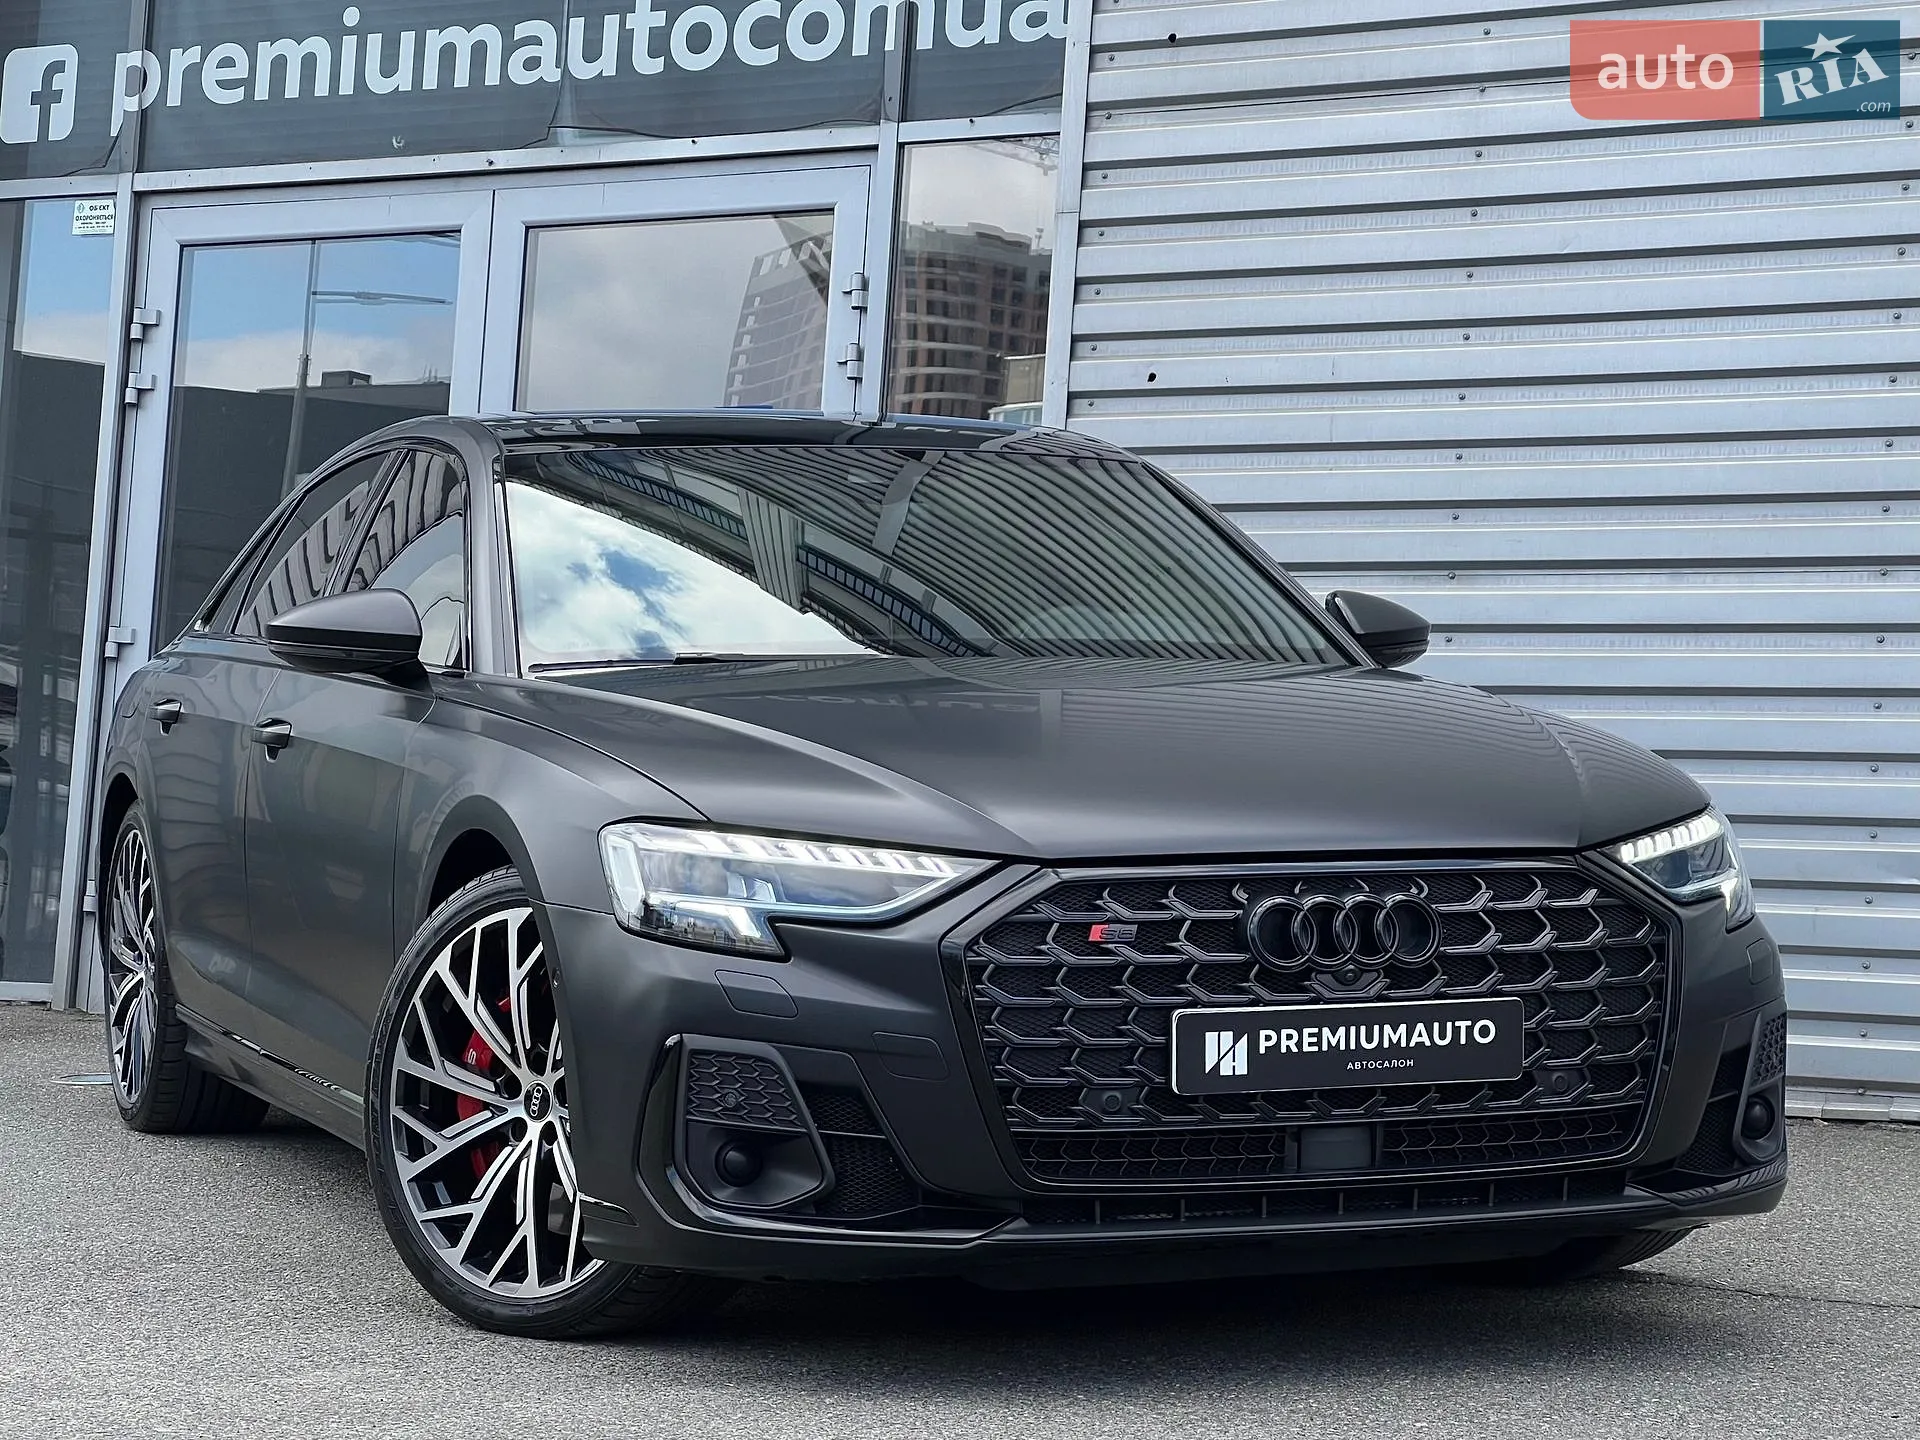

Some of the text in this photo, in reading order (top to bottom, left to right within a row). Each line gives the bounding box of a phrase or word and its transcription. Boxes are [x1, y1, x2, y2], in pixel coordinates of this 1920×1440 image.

[110, 0, 1068, 137] premiumautocomua
[1258, 1018, 1498, 1055] PREMIUMAUTO
[1346, 1058, 1415, 1071] АВТОСАЛОН
